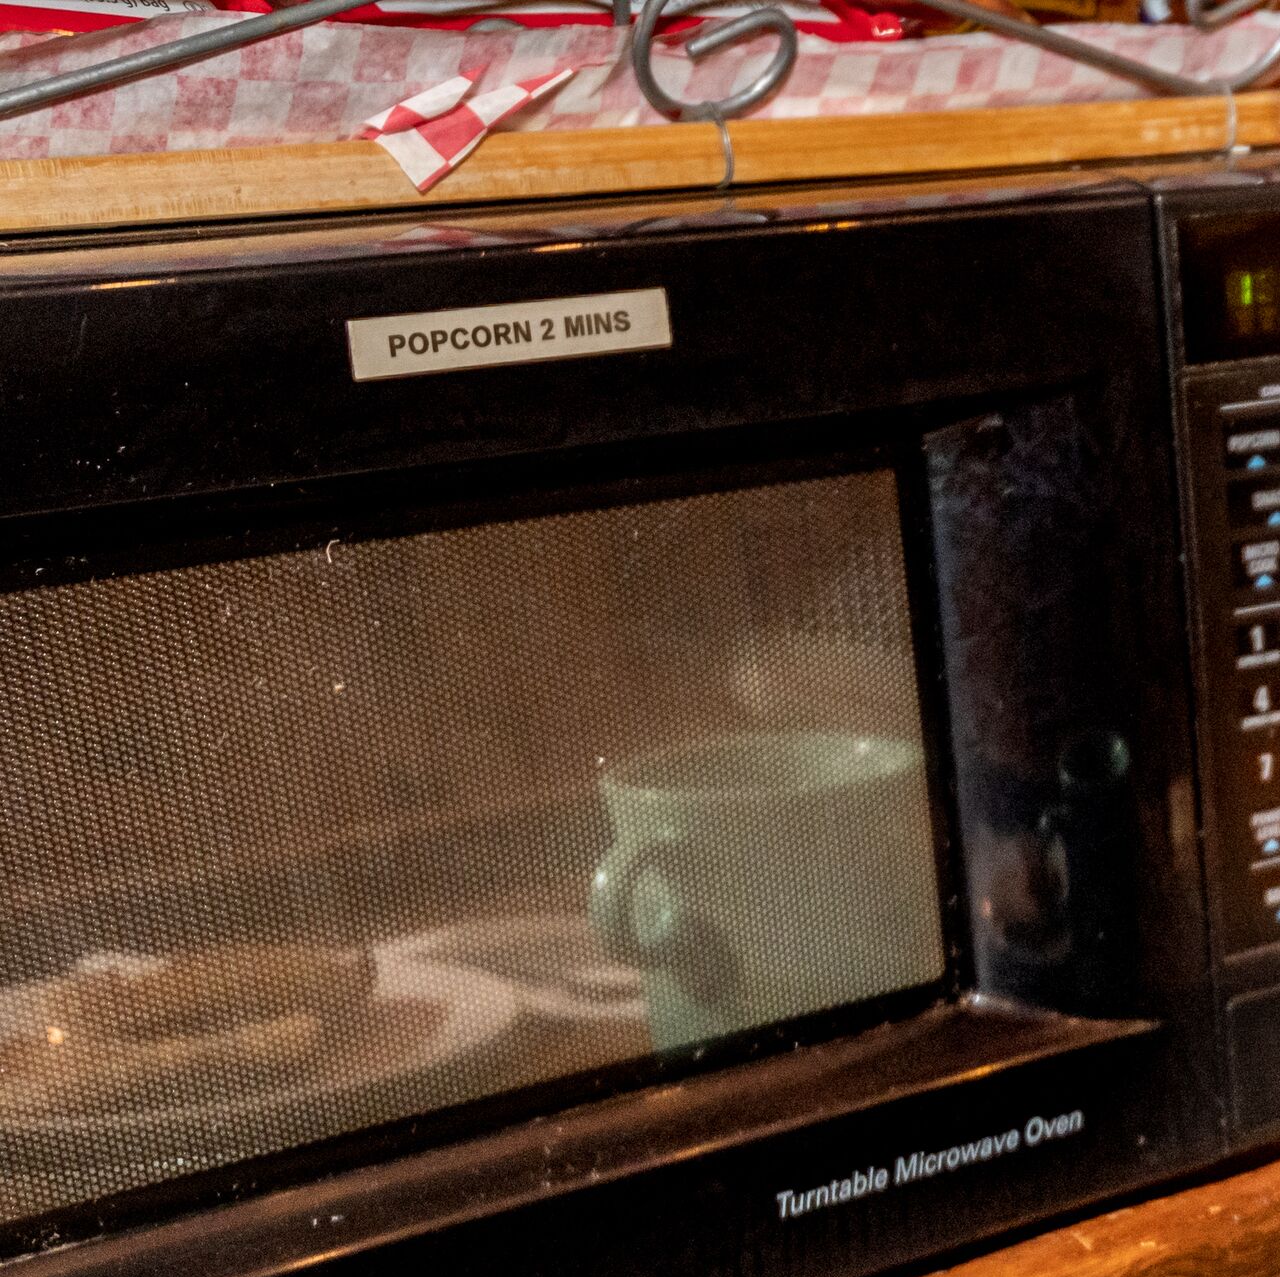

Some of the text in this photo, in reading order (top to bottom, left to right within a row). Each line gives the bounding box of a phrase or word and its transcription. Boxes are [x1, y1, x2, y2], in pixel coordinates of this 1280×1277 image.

[388, 310, 632, 358] POPCORN 2 MINS
[1250, 625, 1263, 651] 1
[1254, 686, 1269, 711] 4
[1260, 753, 1273, 781] 7
[775, 1109, 1085, 1219] Turntable Microwave Oven
